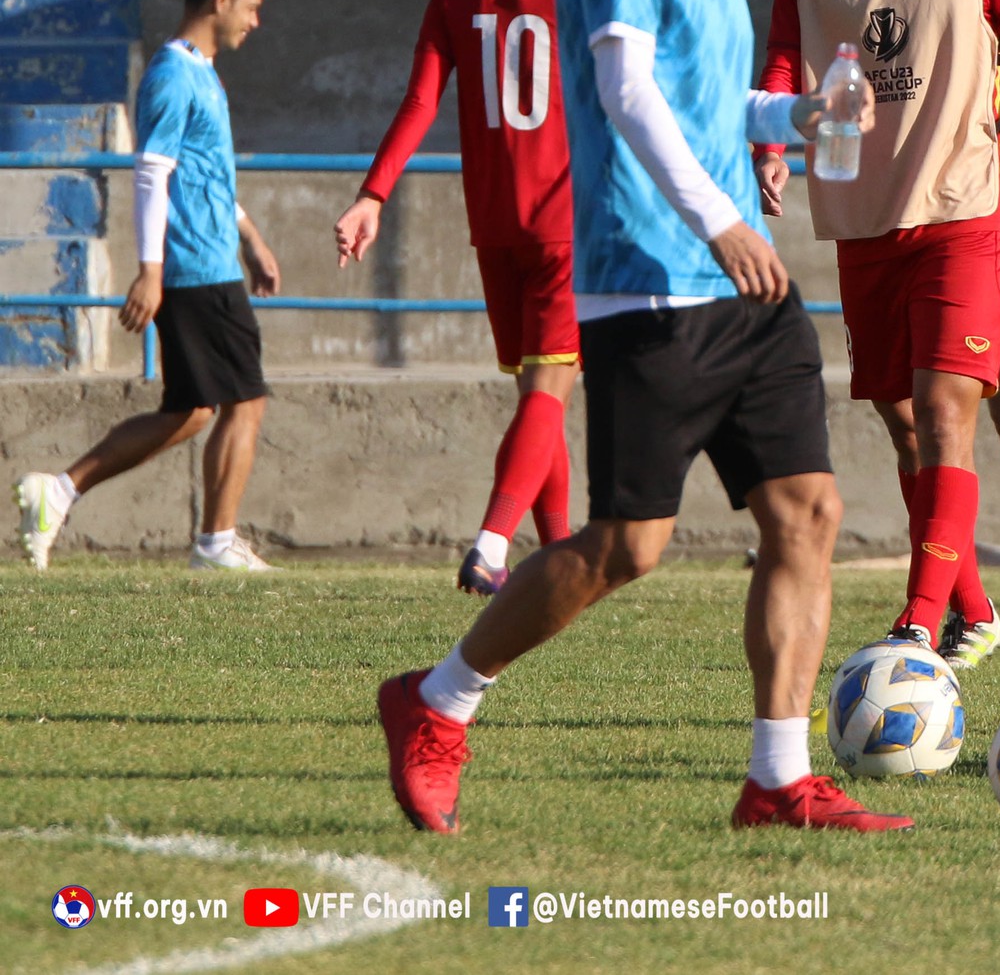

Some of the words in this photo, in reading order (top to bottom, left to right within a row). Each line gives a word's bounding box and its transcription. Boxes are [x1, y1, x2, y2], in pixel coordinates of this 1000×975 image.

[472, 13, 551, 131] 10
[890, 66, 913, 79] U23
[871, 81, 893, 93] IAN
[895, 78, 923, 91] CUP
[900, 91, 916, 101] 2022
